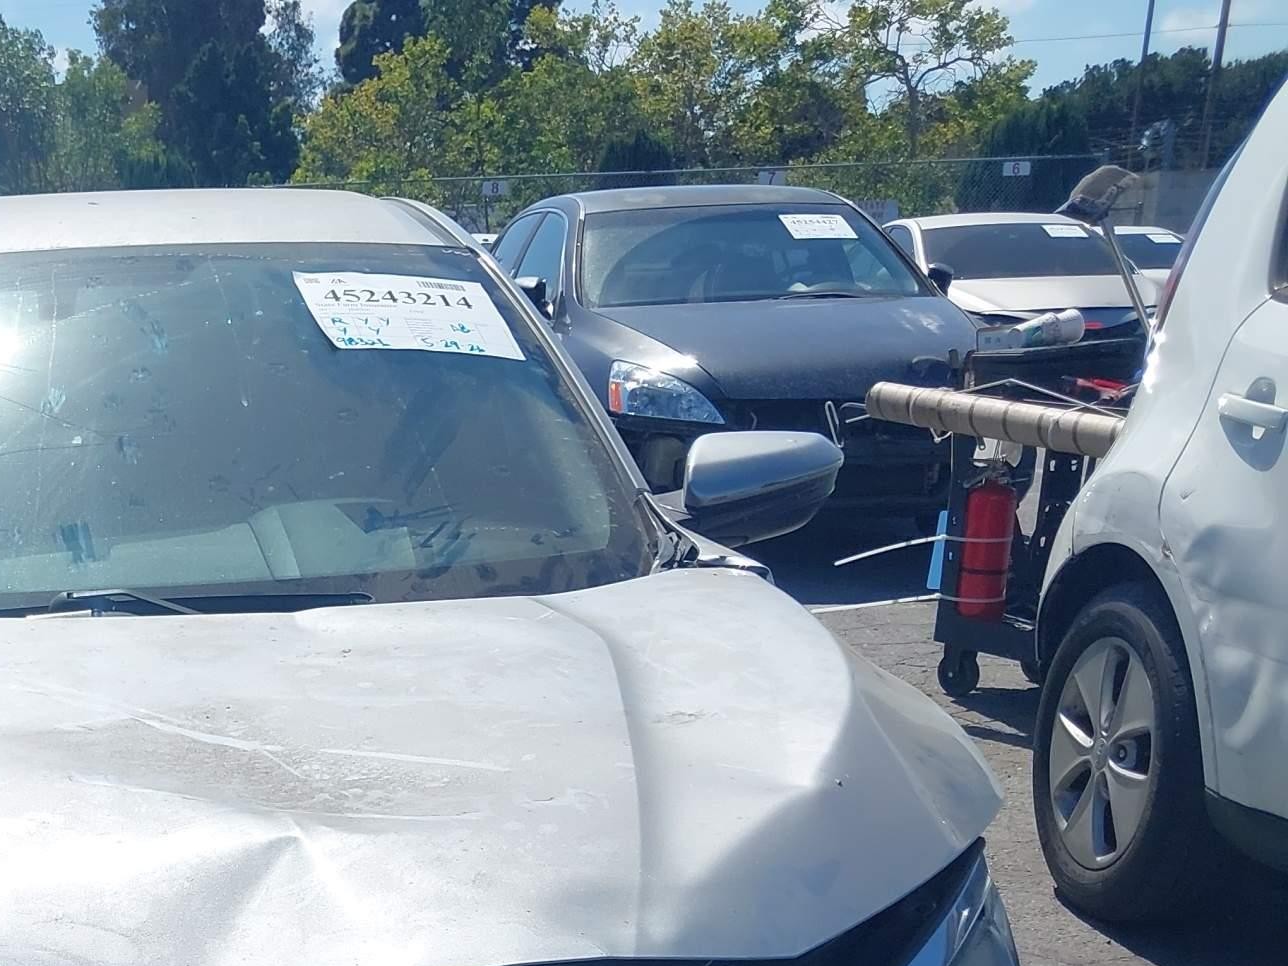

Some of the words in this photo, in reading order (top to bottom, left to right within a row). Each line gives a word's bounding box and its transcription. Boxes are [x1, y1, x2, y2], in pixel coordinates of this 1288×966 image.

[1012, 162, 1020, 175] 6
[768, 171, 777, 185] 7
[491, 182, 499, 194] 8
[324, 289, 473, 310] 45243214
